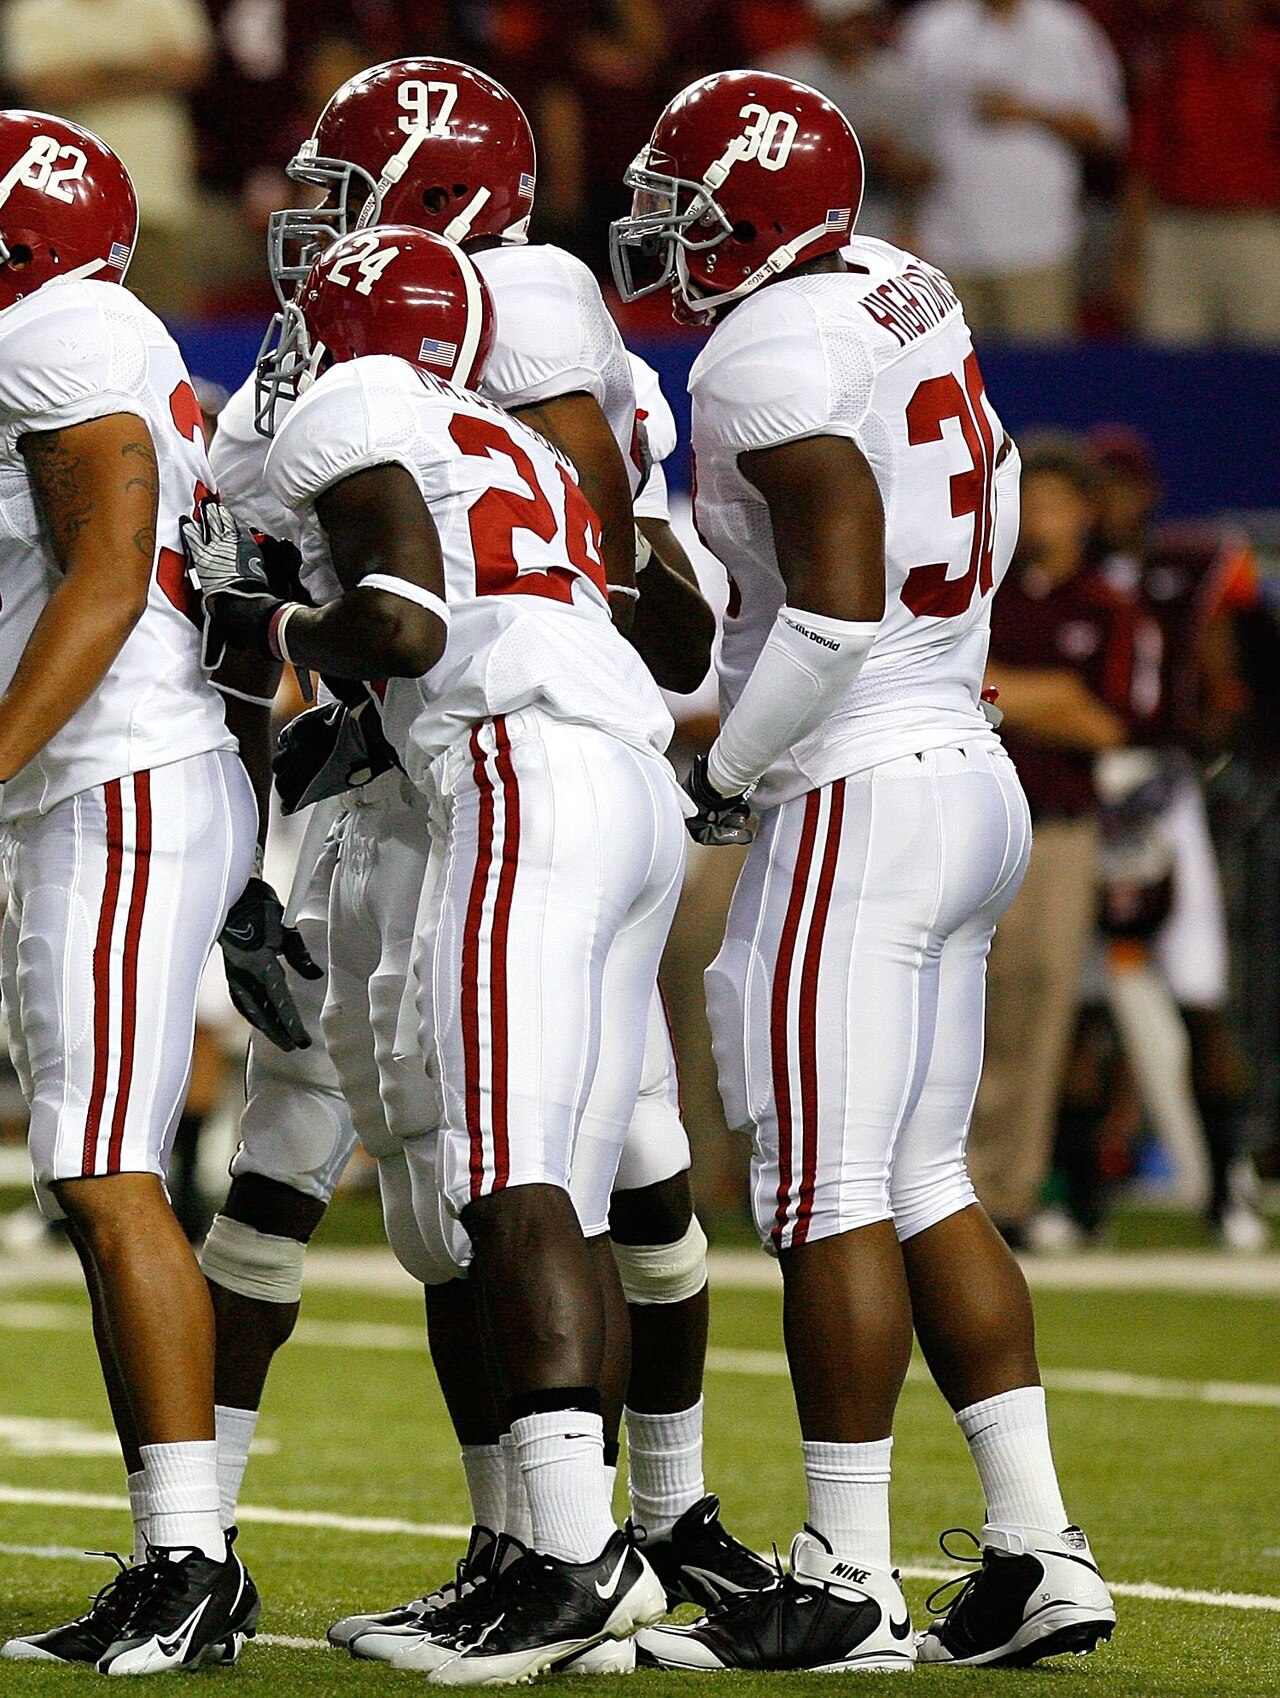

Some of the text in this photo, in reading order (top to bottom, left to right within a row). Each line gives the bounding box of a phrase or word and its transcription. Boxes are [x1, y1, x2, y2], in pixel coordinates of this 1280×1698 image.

[397, 80, 458, 136] 97
[735, 103, 799, 172] 30
[19, 134, 88, 205] 82
[327, 235, 400, 296] 24
[830, 1562, 872, 1585] NIKE
